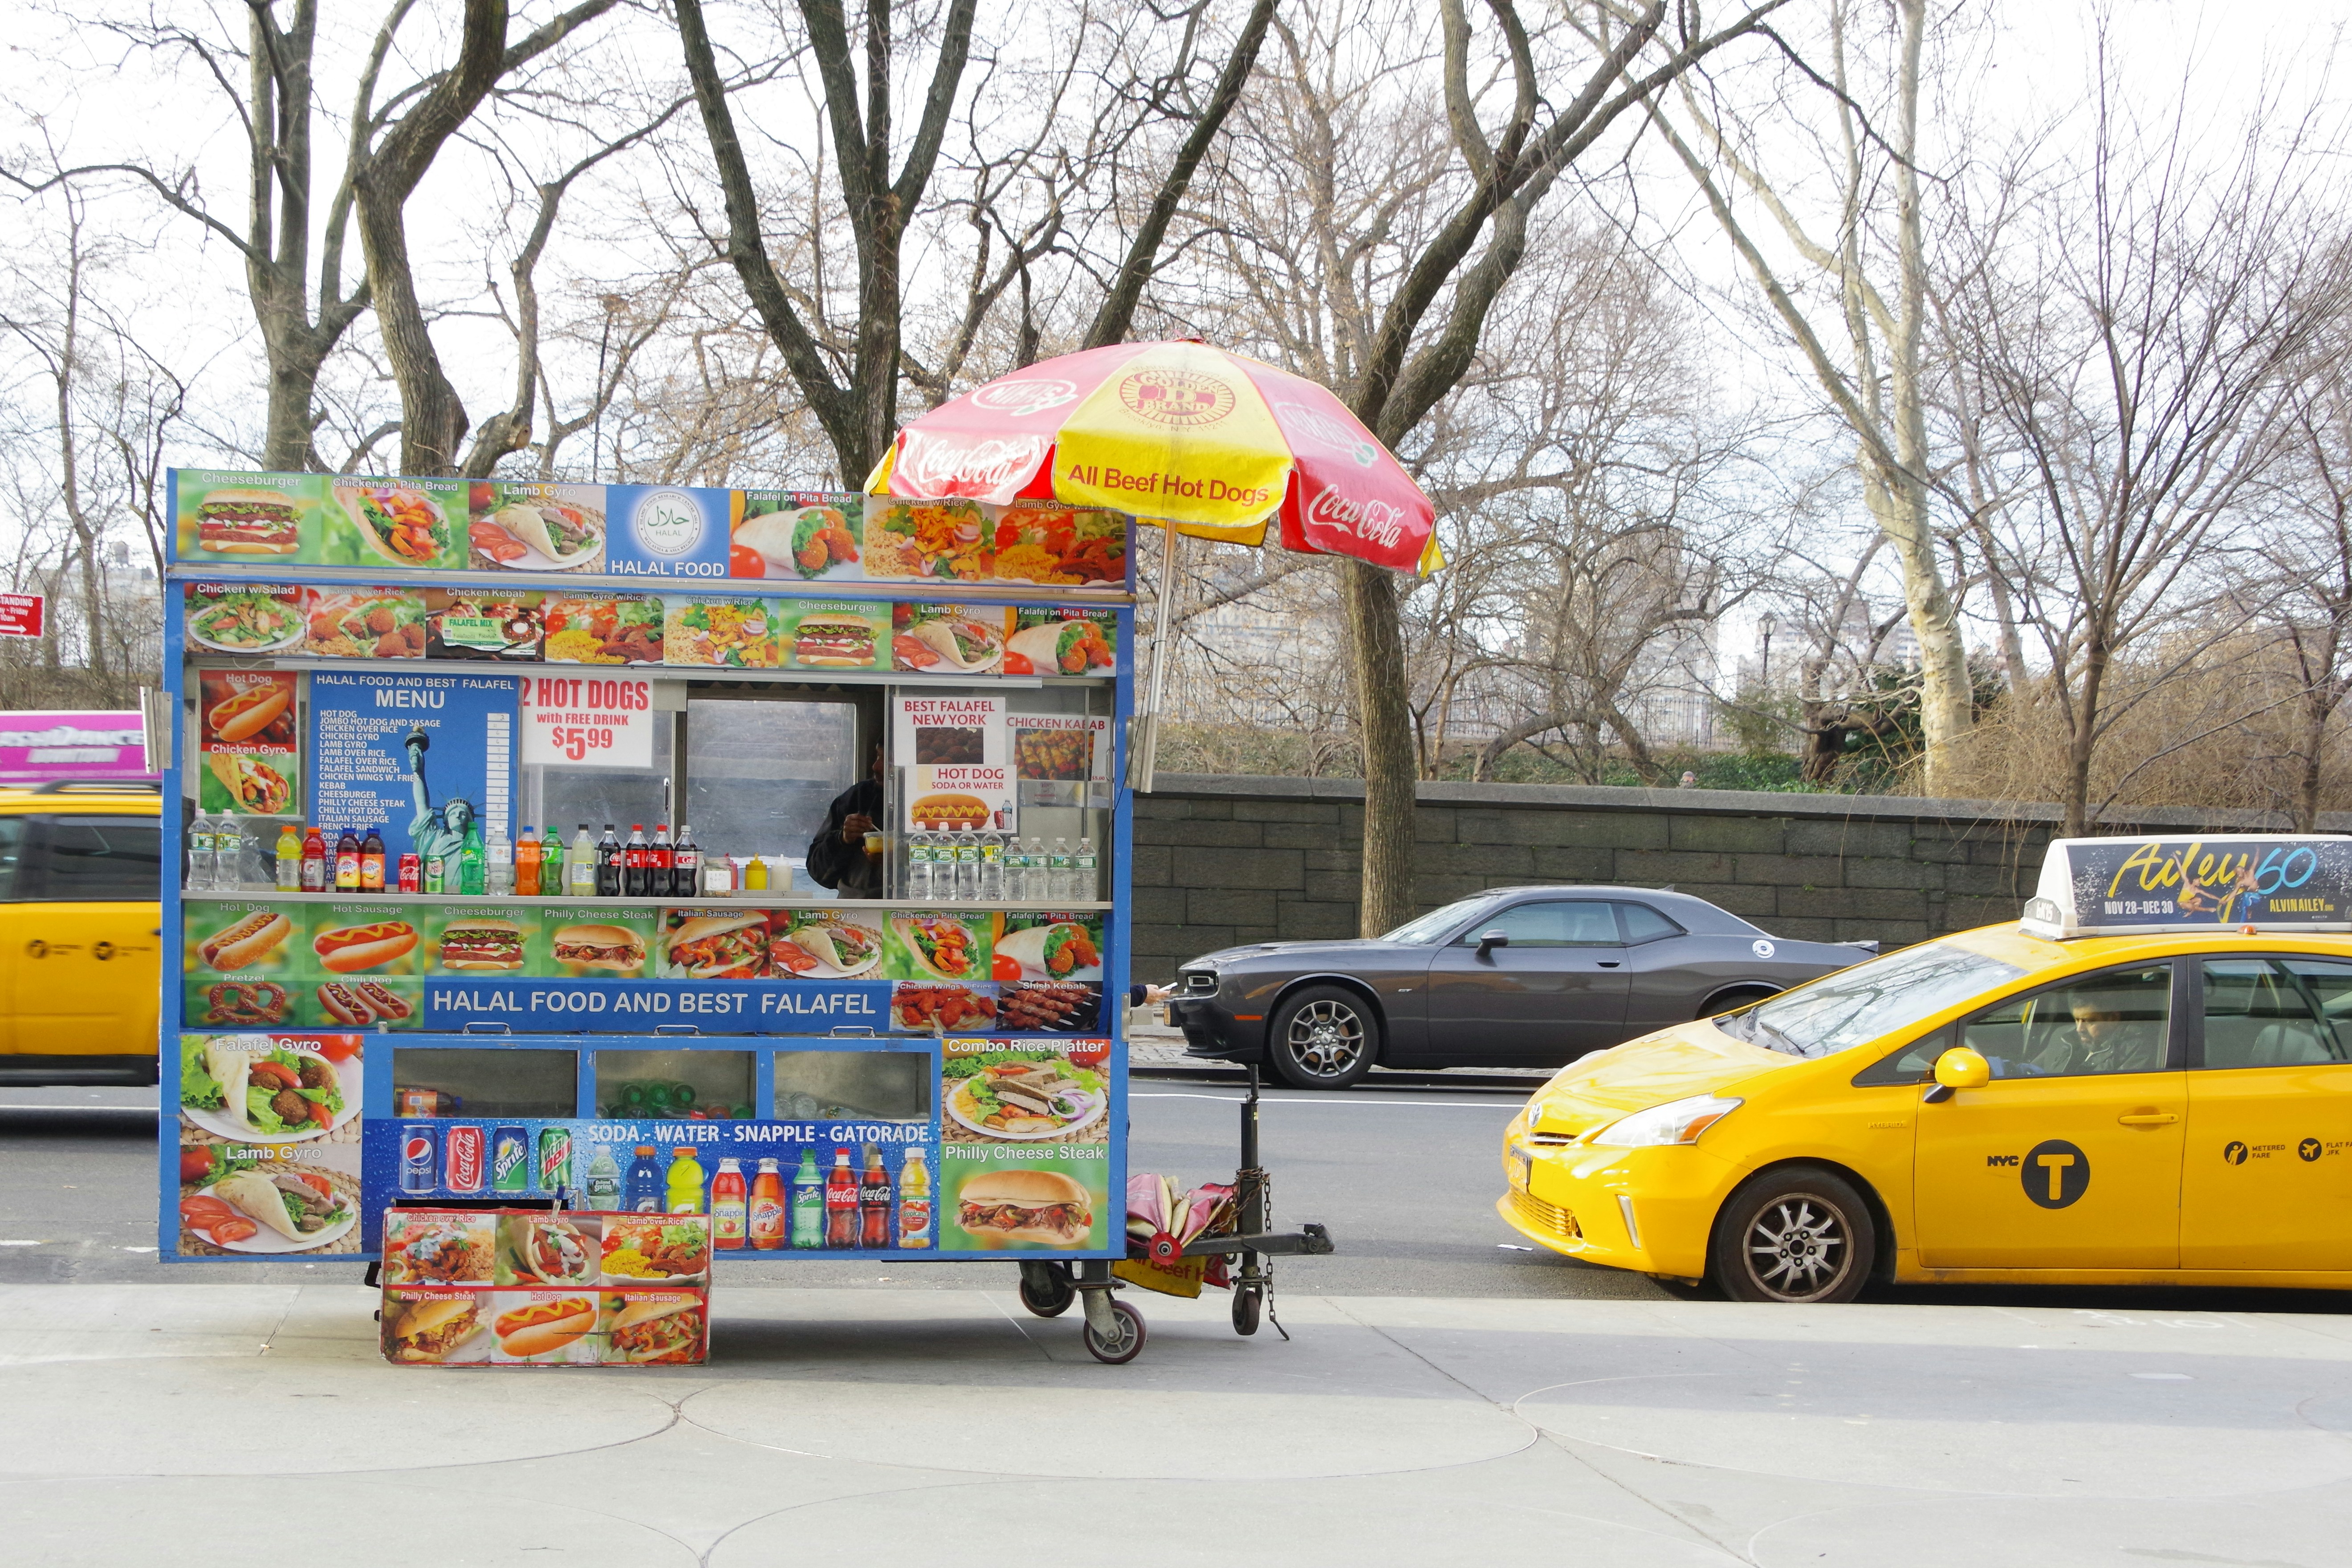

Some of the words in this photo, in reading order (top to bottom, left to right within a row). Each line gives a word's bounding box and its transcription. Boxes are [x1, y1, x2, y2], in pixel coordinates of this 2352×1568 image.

[1140, 373, 1219, 394] GOLDEN
[1144, 400, 1210, 411] BRAND
[202, 472, 302, 488] Cheeseburger
[333, 478, 377, 489] Chicken
[379, 480, 397, 489] on
[400, 479, 422, 490] Pita
[425, 481, 459, 492] Bread
[1068, 464, 1098, 486] All
[1105, 468, 1158, 493] Beef
[1163, 475, 1204, 499] Hot
[1209, 481, 1269, 507] Dogs
[503, 485, 541, 497] Lamb
[543, 485, 577, 498] Gyro
[746, 491, 781, 501] Falafel
[783, 494, 797, 502] on
[799, 492, 819, 503] Pita
[822, 493, 853, 504] Bread
[611, 559, 670, 575] HALAL
[674, 562, 725, 577] FOOD
[197, 583, 251, 595] Chicken
[253, 583, 296, 595] w/Salad
[446, 588, 489, 598] Chicken
[492, 589, 526, 599] Kebab
[0, 596, 33, 607] TANDING
[226, 673, 246, 683] Hot
[249, 674, 272, 685] Dog
[317, 675, 356, 685] HALAL
[359, 676, 394, 686] FOOD
[396, 677, 423, 687] AND
[426, 678, 457, 688] BEST
[462, 679, 514, 690] FALAFEL
[375, 689, 445, 709] MENU
[537, 678, 582, 708] HOT
[588, 680, 649, 710] DOGS
[904, 701, 936, 712] BEST
[940, 701, 995, 712] FALAFEL
[320, 717, 349, 725] JOMBO
[350, 717, 368, 725] HOT
[409, 719, 441, 727] SASAGE
[537, 713, 562, 723] with
[566, 713, 590, 725] FREE
[594, 714, 629, 726] DRINK
[913, 714, 946, 725] NEW
[948, 714, 987, 725] YORK
[1007, 717, 1062, 729] CHICKEN
[319, 724, 355, 732] CHICKEN
[319, 732, 355, 740] CHICKEN
[357, 733, 379, 741] GYRO
[211, 744, 257, 755] Chicken
[260, 744, 287, 756] Gyro
[355, 765, 400, 774] SANDWICH
[938, 768, 968, 779] HOT
[972, 768, 1005, 780] DOG
[932, 782, 957, 790] SODA
[959, 782, 972, 790] OR
[973, 782, 1004, 790] WATER
[318, 790, 377, 798] CHEESBURGER
[318, 815, 350, 823] ITALIAN
[352, 815, 390, 823] SAUSAGE
[2108, 843, 2249, 924] Ailey
[2256, 847, 2317, 895] 60
[220, 903, 241, 911] Hot
[247, 903, 270, 913] Dog
[333, 904, 354, 913] Hot
[355, 905, 403, 914] Sausage
[444, 907, 525, 918] Cheeseburger
[2104, 900, 2124, 915] NOV
[2162, 900, 2174, 914] 30
[678, 909, 704, 918] Italian
[706, 909, 744, 919] Sausage
[341, 975, 366, 983] Chili
[370, 976, 392, 985] Dog
[1023, 982, 1051, 990] Shish
[1053, 982, 1086, 991] Kebab
[434, 990, 523, 1012] HALAL
[531, 991, 607, 1013] FOOD
[613, 992, 671, 1013] AND
[679, 992, 749, 1014] BEST
[761, 993, 876, 1014] FALAFEL
[216, 1038, 274, 1051] Falafel
[279, 1039, 322, 1054] Gyro
[948, 1039, 1006, 1053] Combo
[1010, 1039, 1046, 1053] Rice
[1051, 1039, 1106, 1053] Platter
[588, 1124, 640, 1142] SODA
[655, 1125, 719, 1142] WATER
[734, 1125, 815, 1142] SNAPPLE
[830, 1125, 928, 1143] GATORADE
[945, 1146, 990, 1163] Philly
[993, 1146, 1054, 1160] Cheese
[1058, 1146, 1105, 1160] Steak
[496, 1145, 525, 1180] Sprite
[1987, 1155, 2019, 1167] NYC
[406, 1166, 431, 1176] pepsi
[2036, 1153, 2075, 1200] T
[798, 1191, 820, 1204] Sprite
[714, 1207, 744, 1219] Snapple
[903, 1210, 927, 1218] Tropicana
[627, 1216, 647, 1225] Lamb
[668, 1217, 684, 1225] Rice
[401, 1291, 424, 1302] Philly
[425, 1292, 453, 1301] Cheese
[455, 1292, 476, 1301] Steak
[531, 1292, 545, 1301] Hot
[546, 1292, 562, 1302] Dog
